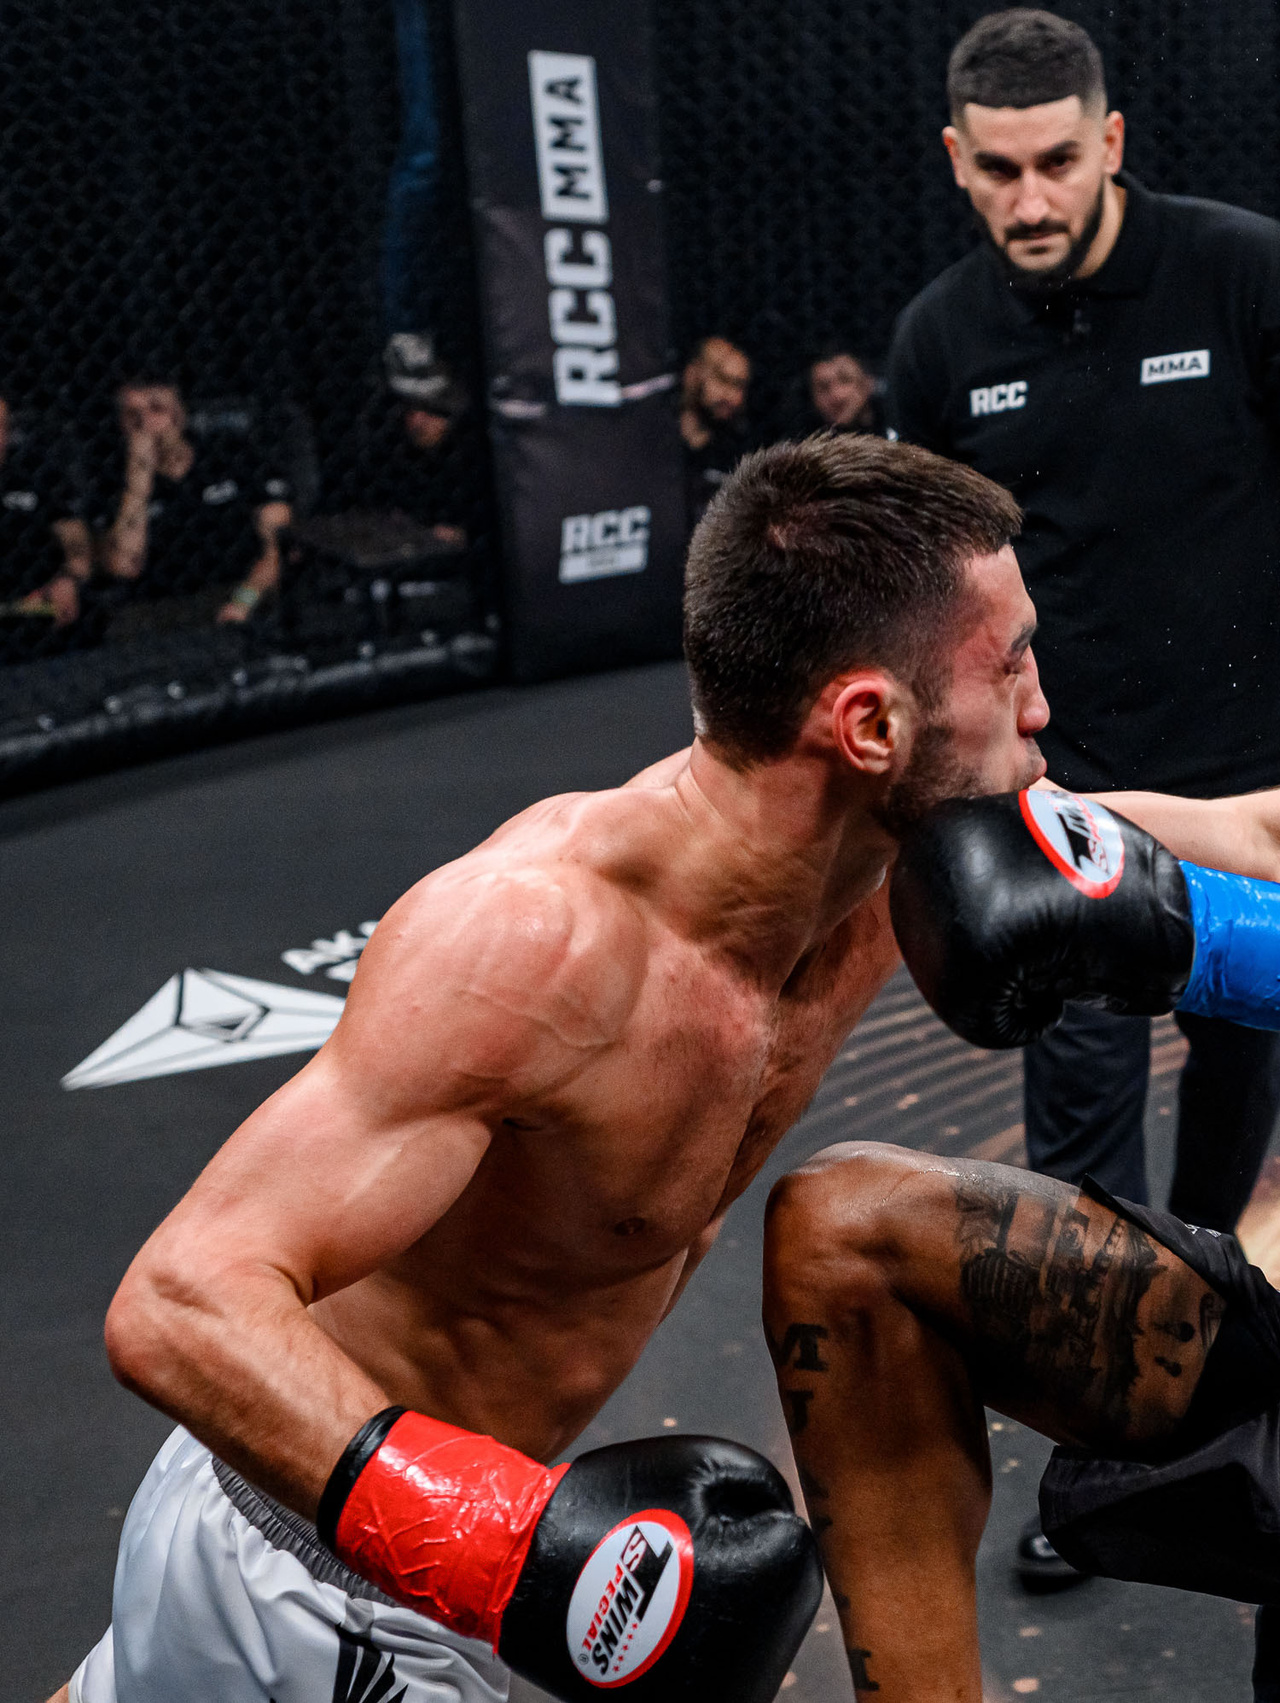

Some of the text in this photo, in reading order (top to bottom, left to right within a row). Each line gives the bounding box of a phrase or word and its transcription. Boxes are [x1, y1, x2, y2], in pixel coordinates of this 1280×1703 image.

[543, 73, 622, 408] RCC MMA
[970, 380, 1028, 417] RCC
[1146, 355, 1204, 378] MMA
[591, 1526, 674, 1676] TWINS
